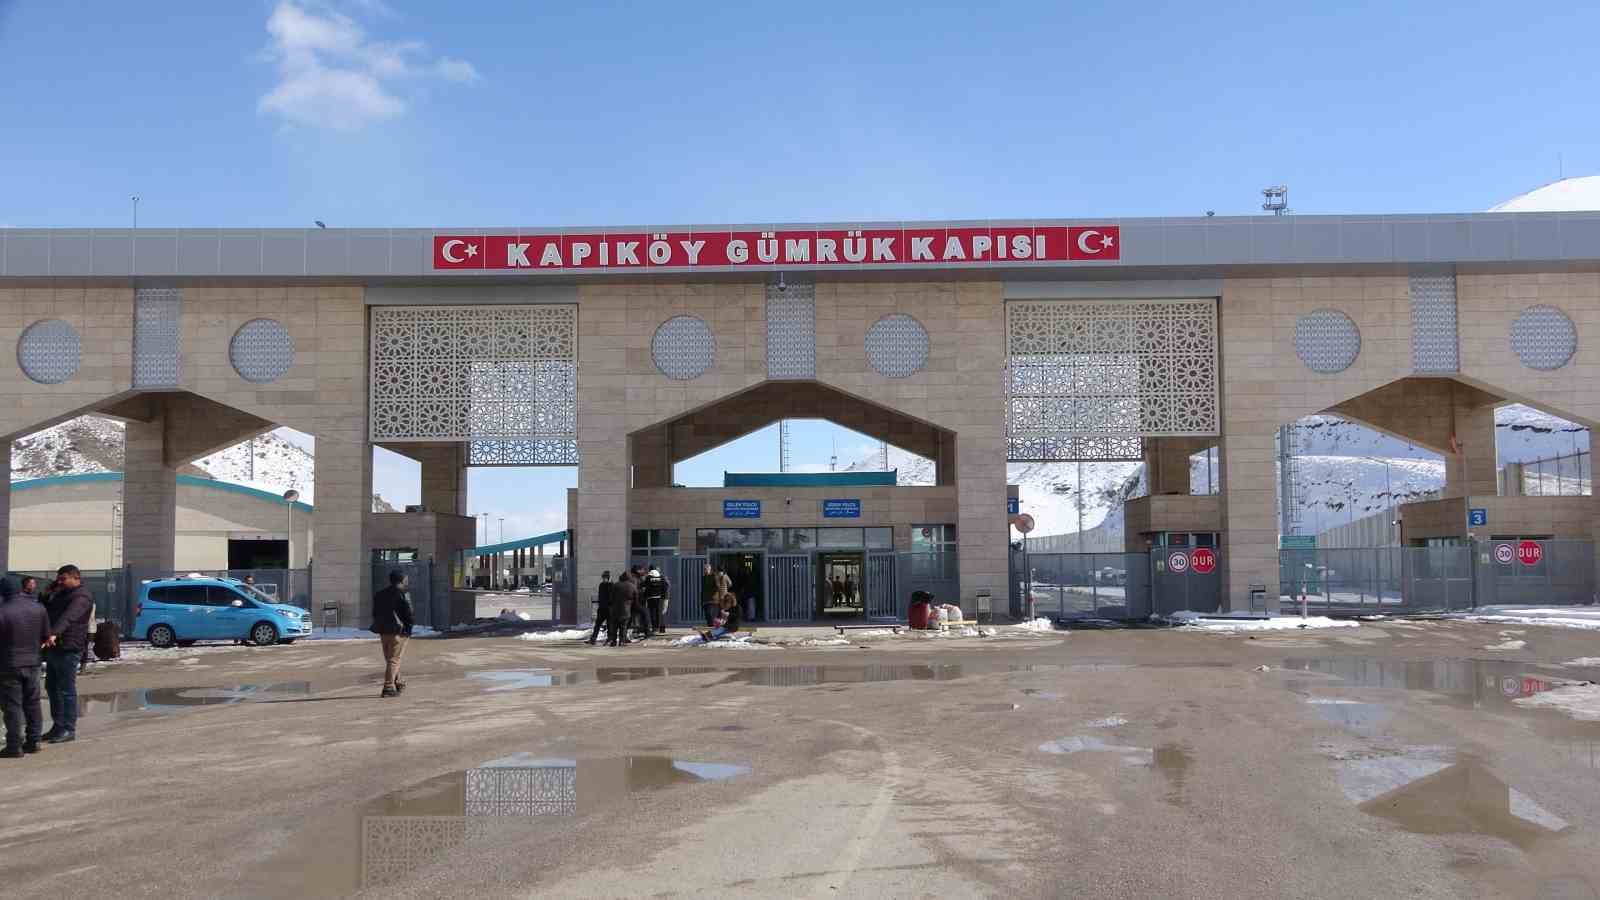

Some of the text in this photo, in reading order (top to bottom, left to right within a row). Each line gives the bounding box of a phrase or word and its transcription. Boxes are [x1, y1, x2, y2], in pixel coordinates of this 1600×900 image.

[507, 231, 1046, 267] KAPIKÖY GÜMRÜK KAPISI
[1474, 514, 1483, 525] 3
[1499, 550, 1511, 558] 30
[1518, 547, 1540, 558] DUR
[1173, 558, 1185, 566] 30
[1192, 555, 1214, 566] DUR
